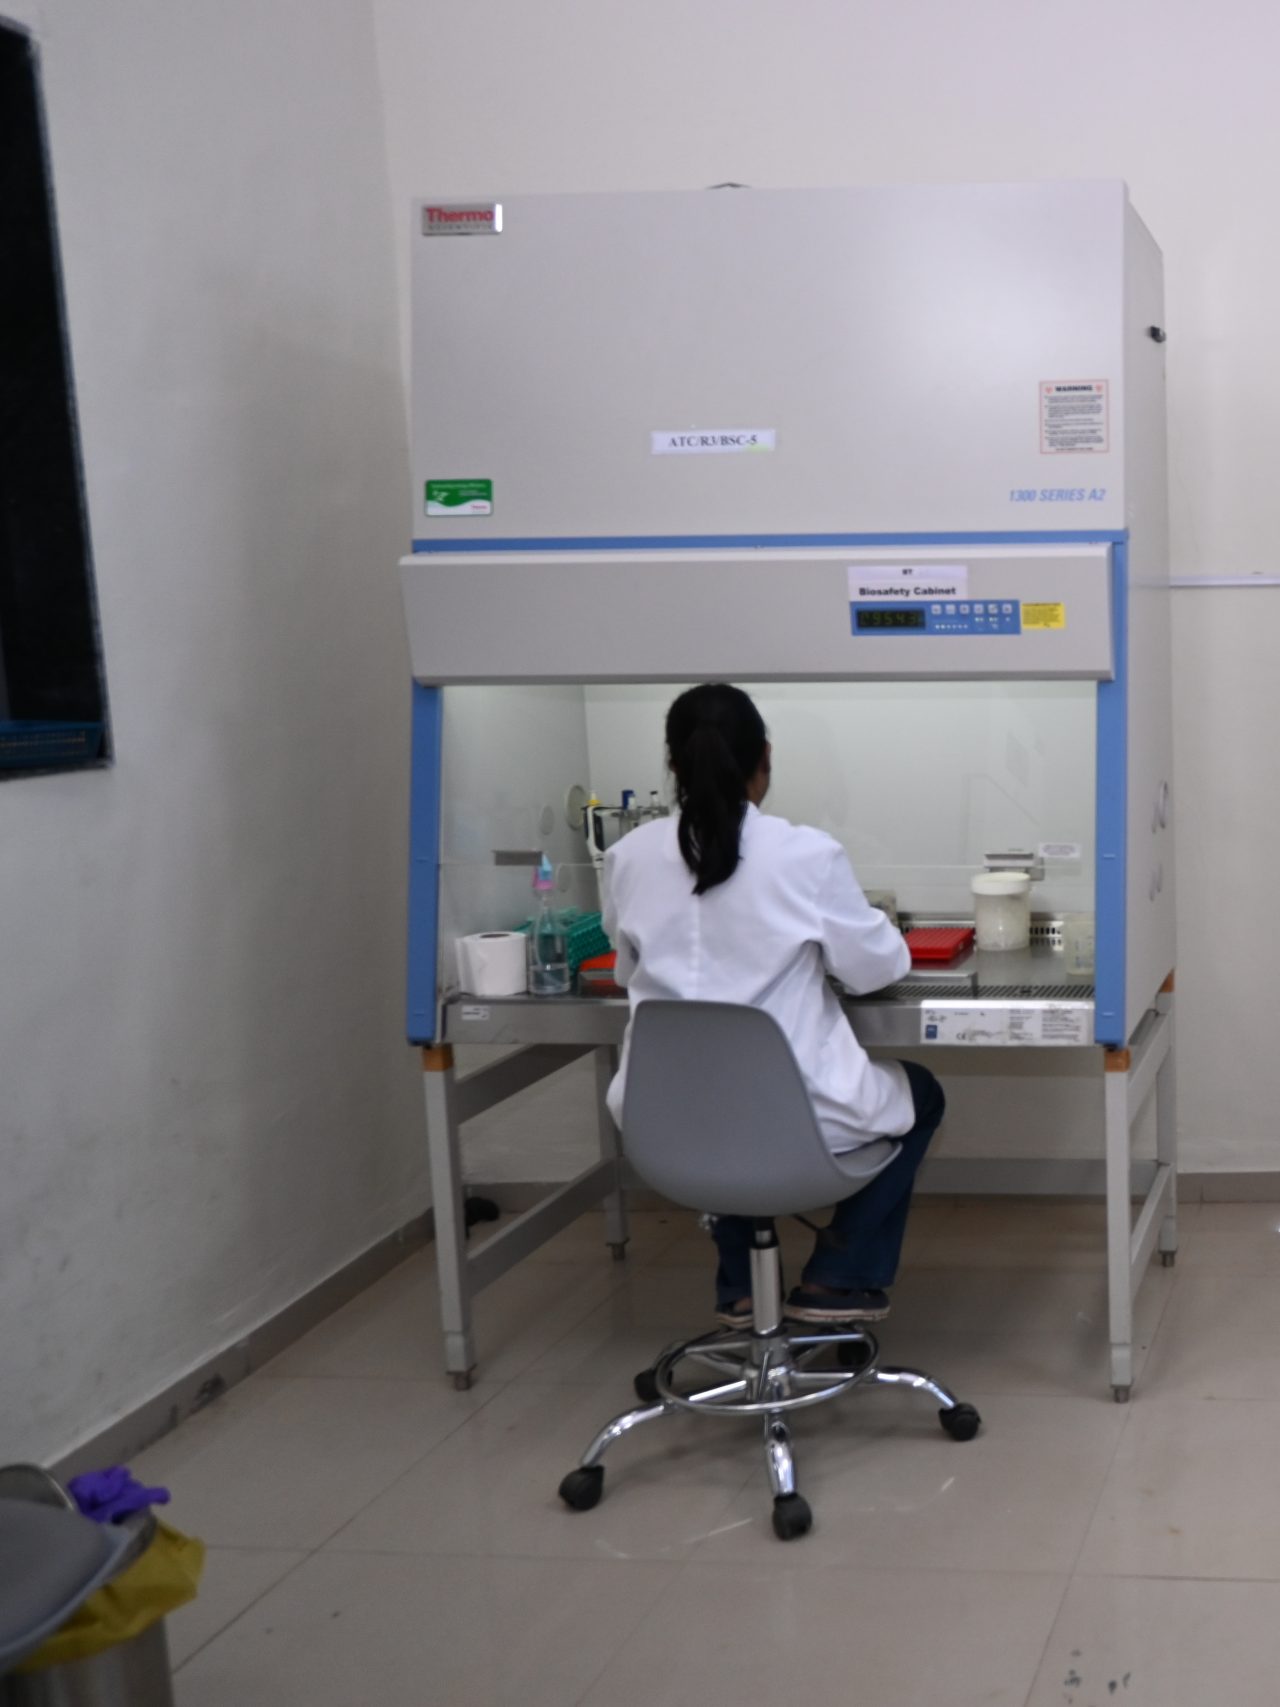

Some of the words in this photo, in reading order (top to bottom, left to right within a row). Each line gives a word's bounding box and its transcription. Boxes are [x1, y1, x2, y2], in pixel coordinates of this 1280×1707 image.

[425, 207, 494, 223] Thermo
[1039, 488, 1085, 501] SERIES
[1088, 488, 1106, 501] A2
[859, 587, 910, 597] Biosafety
[913, 586, 956, 595] Cabinet
